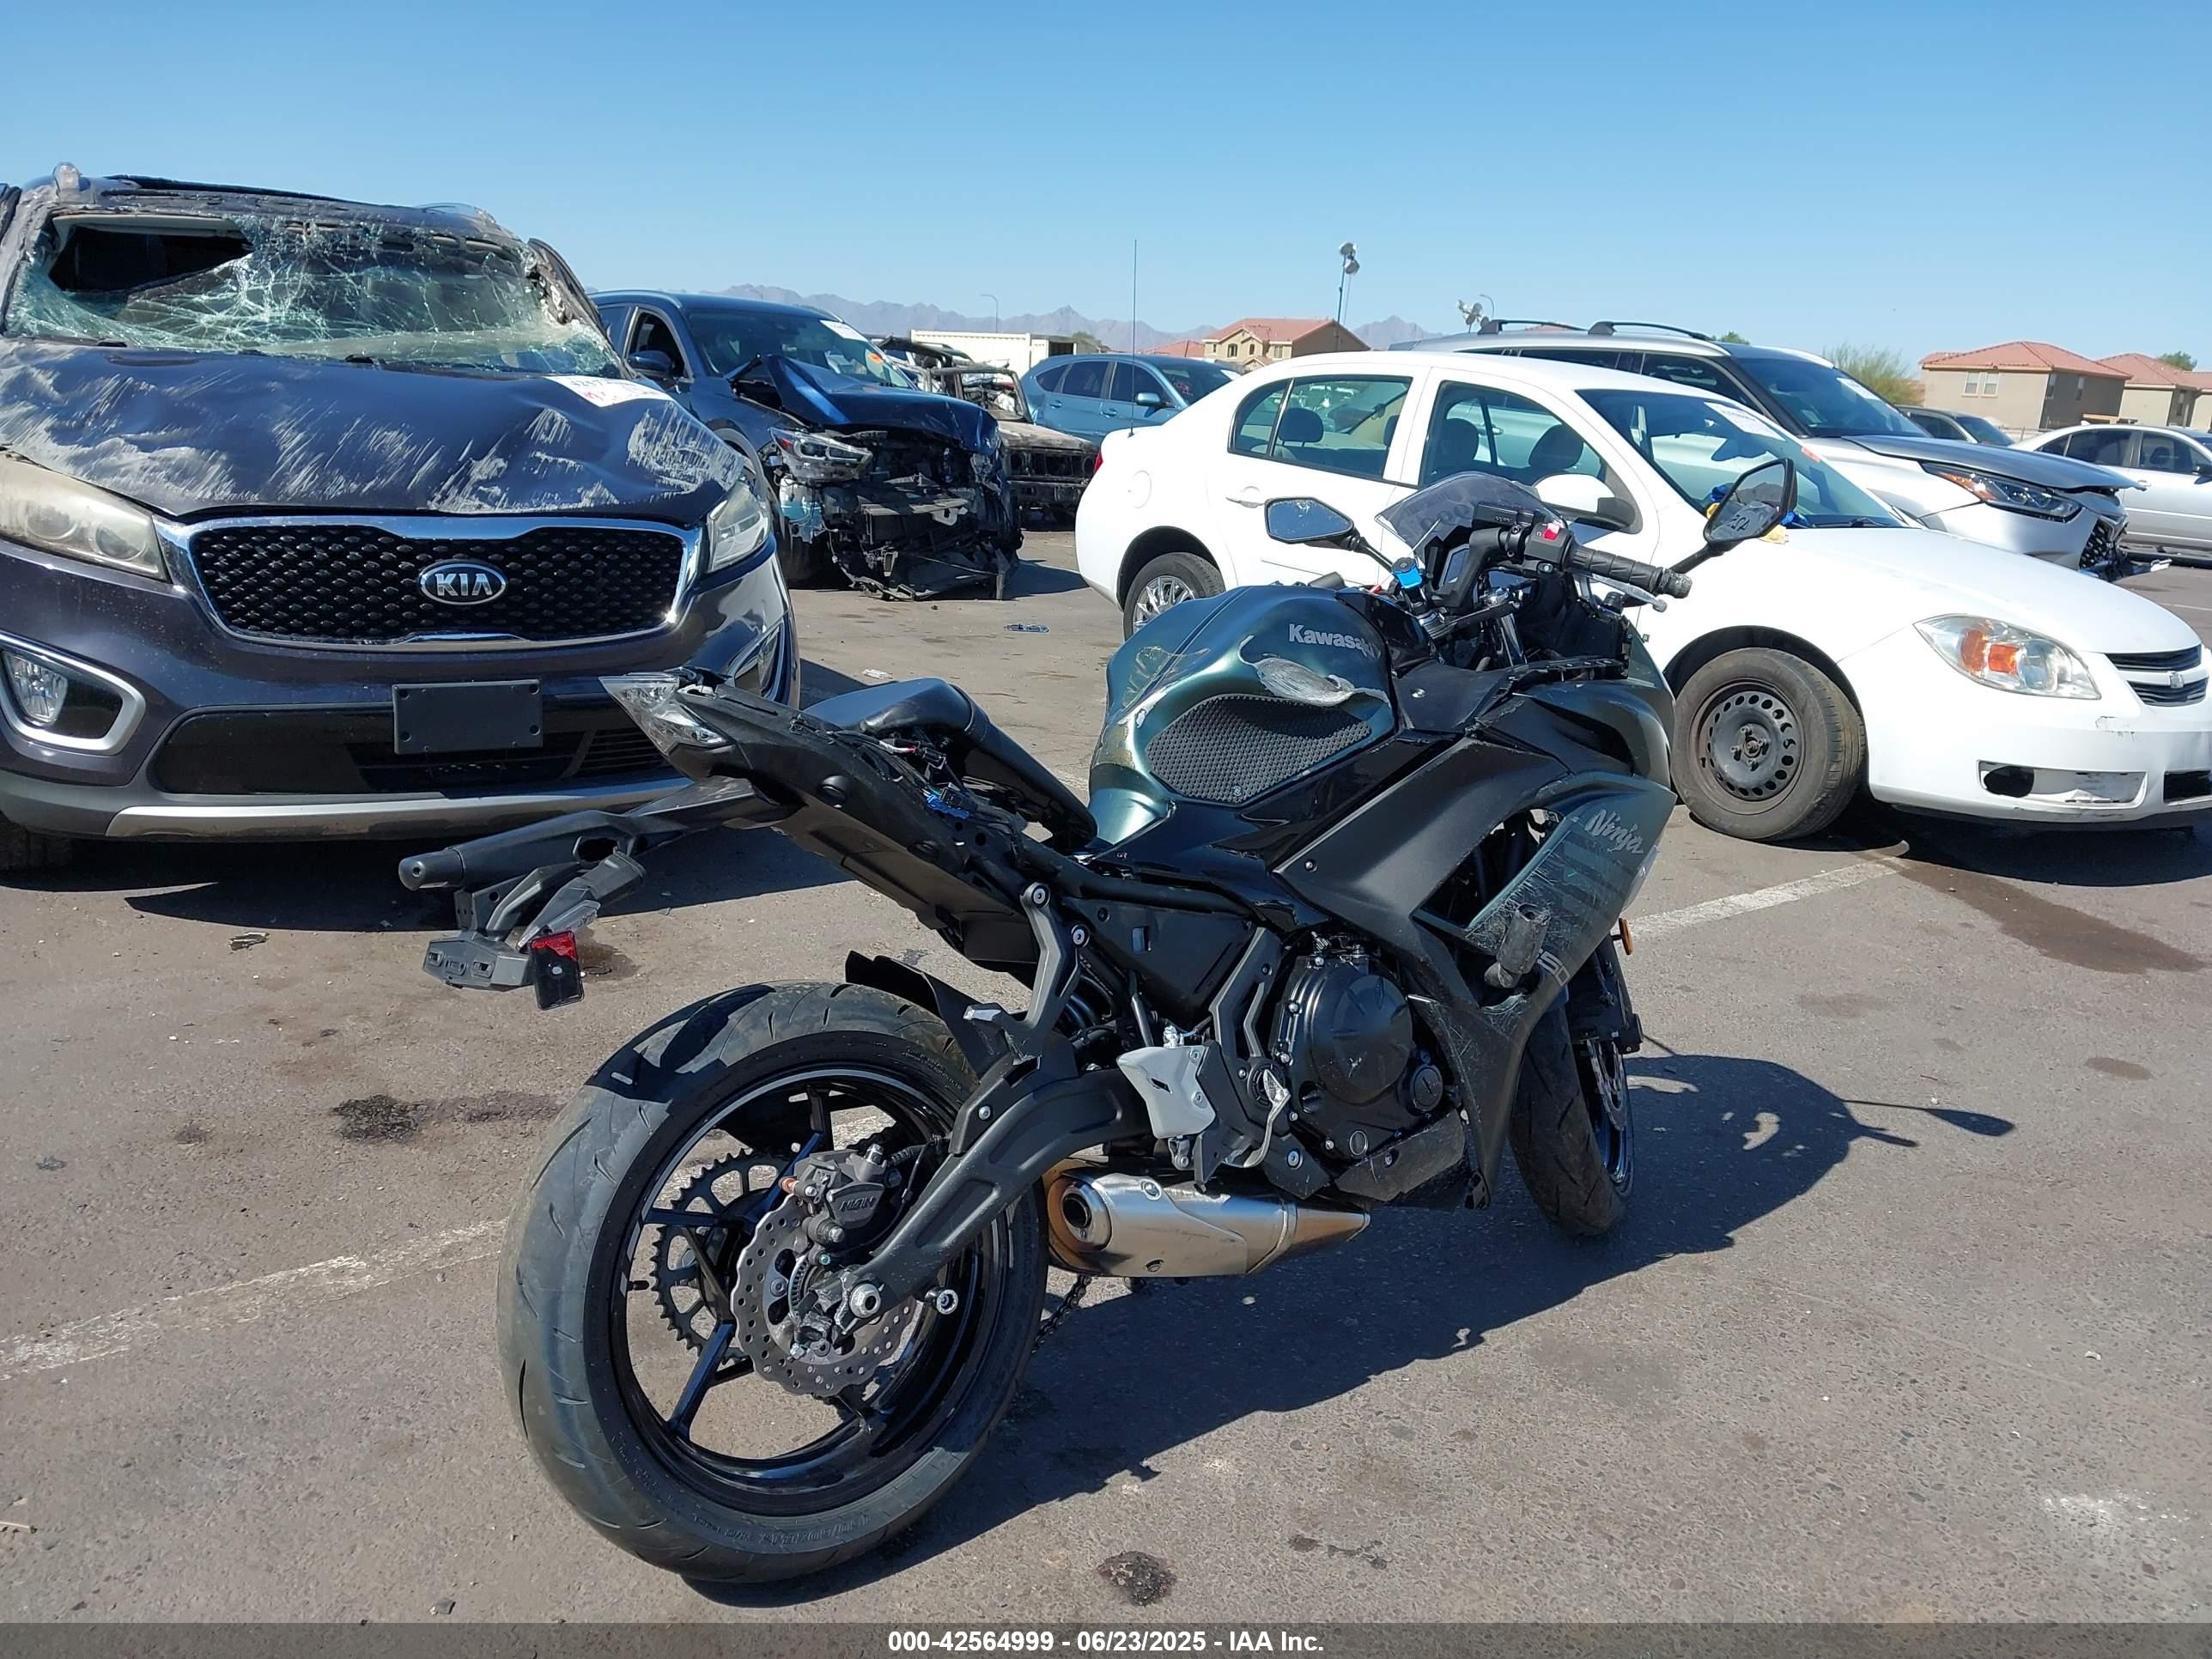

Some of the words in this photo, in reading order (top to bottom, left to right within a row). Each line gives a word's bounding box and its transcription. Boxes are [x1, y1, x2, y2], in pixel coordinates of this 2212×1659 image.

[434, 573, 493, 596] KIA
[1584, 809, 1644, 854] Ninja
[1537, 948, 1571, 987] 50
